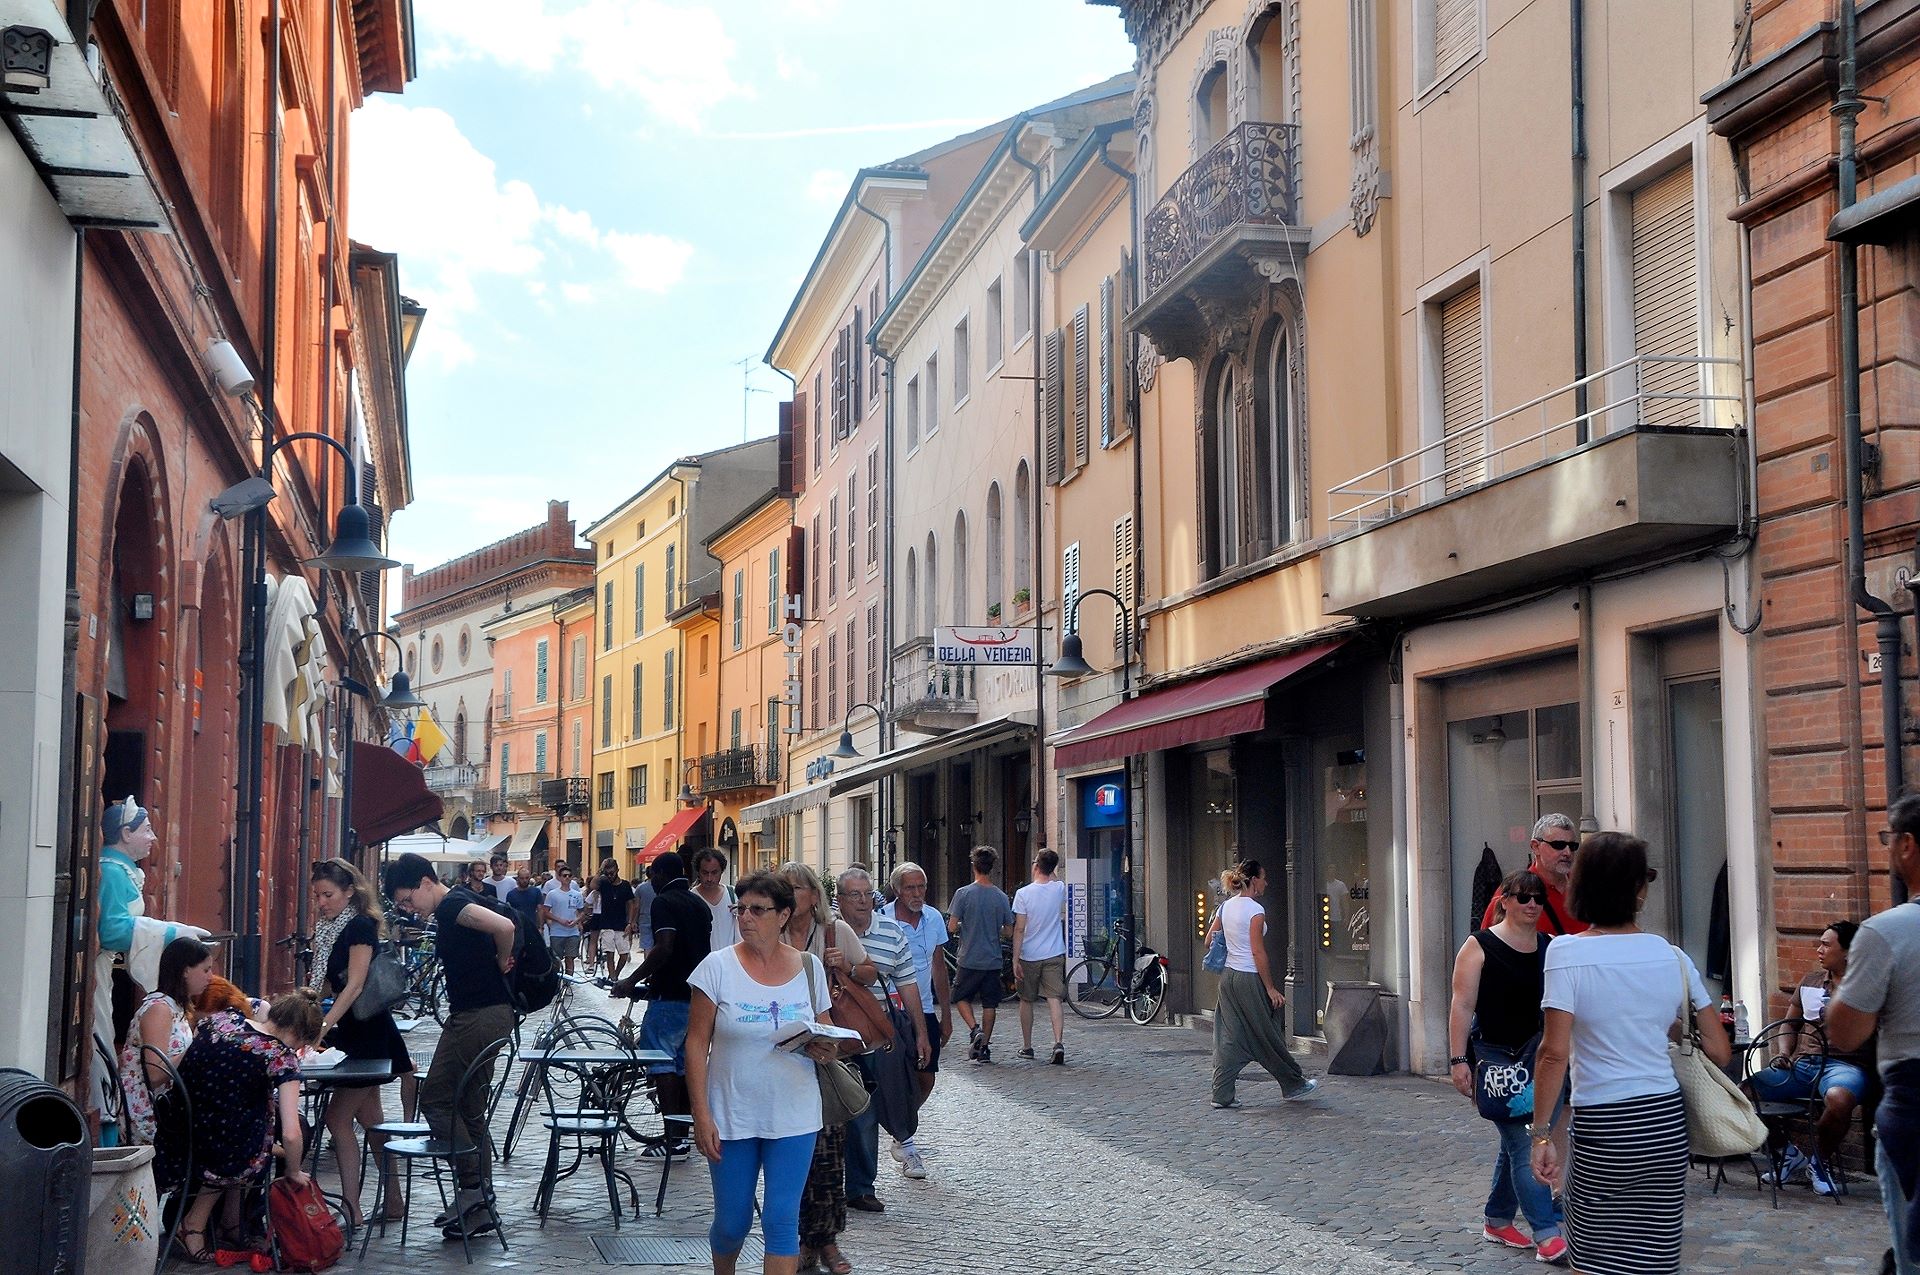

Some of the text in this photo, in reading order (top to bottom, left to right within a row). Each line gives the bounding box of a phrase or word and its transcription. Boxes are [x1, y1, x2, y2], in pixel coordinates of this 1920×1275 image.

[783, 594, 801, 734] HOTEL
[939, 646, 1032, 662] BELLA VENEZIA
[72, 744, 93, 1026] PIADINA
[1483, 1067, 1530, 1090] AERO
